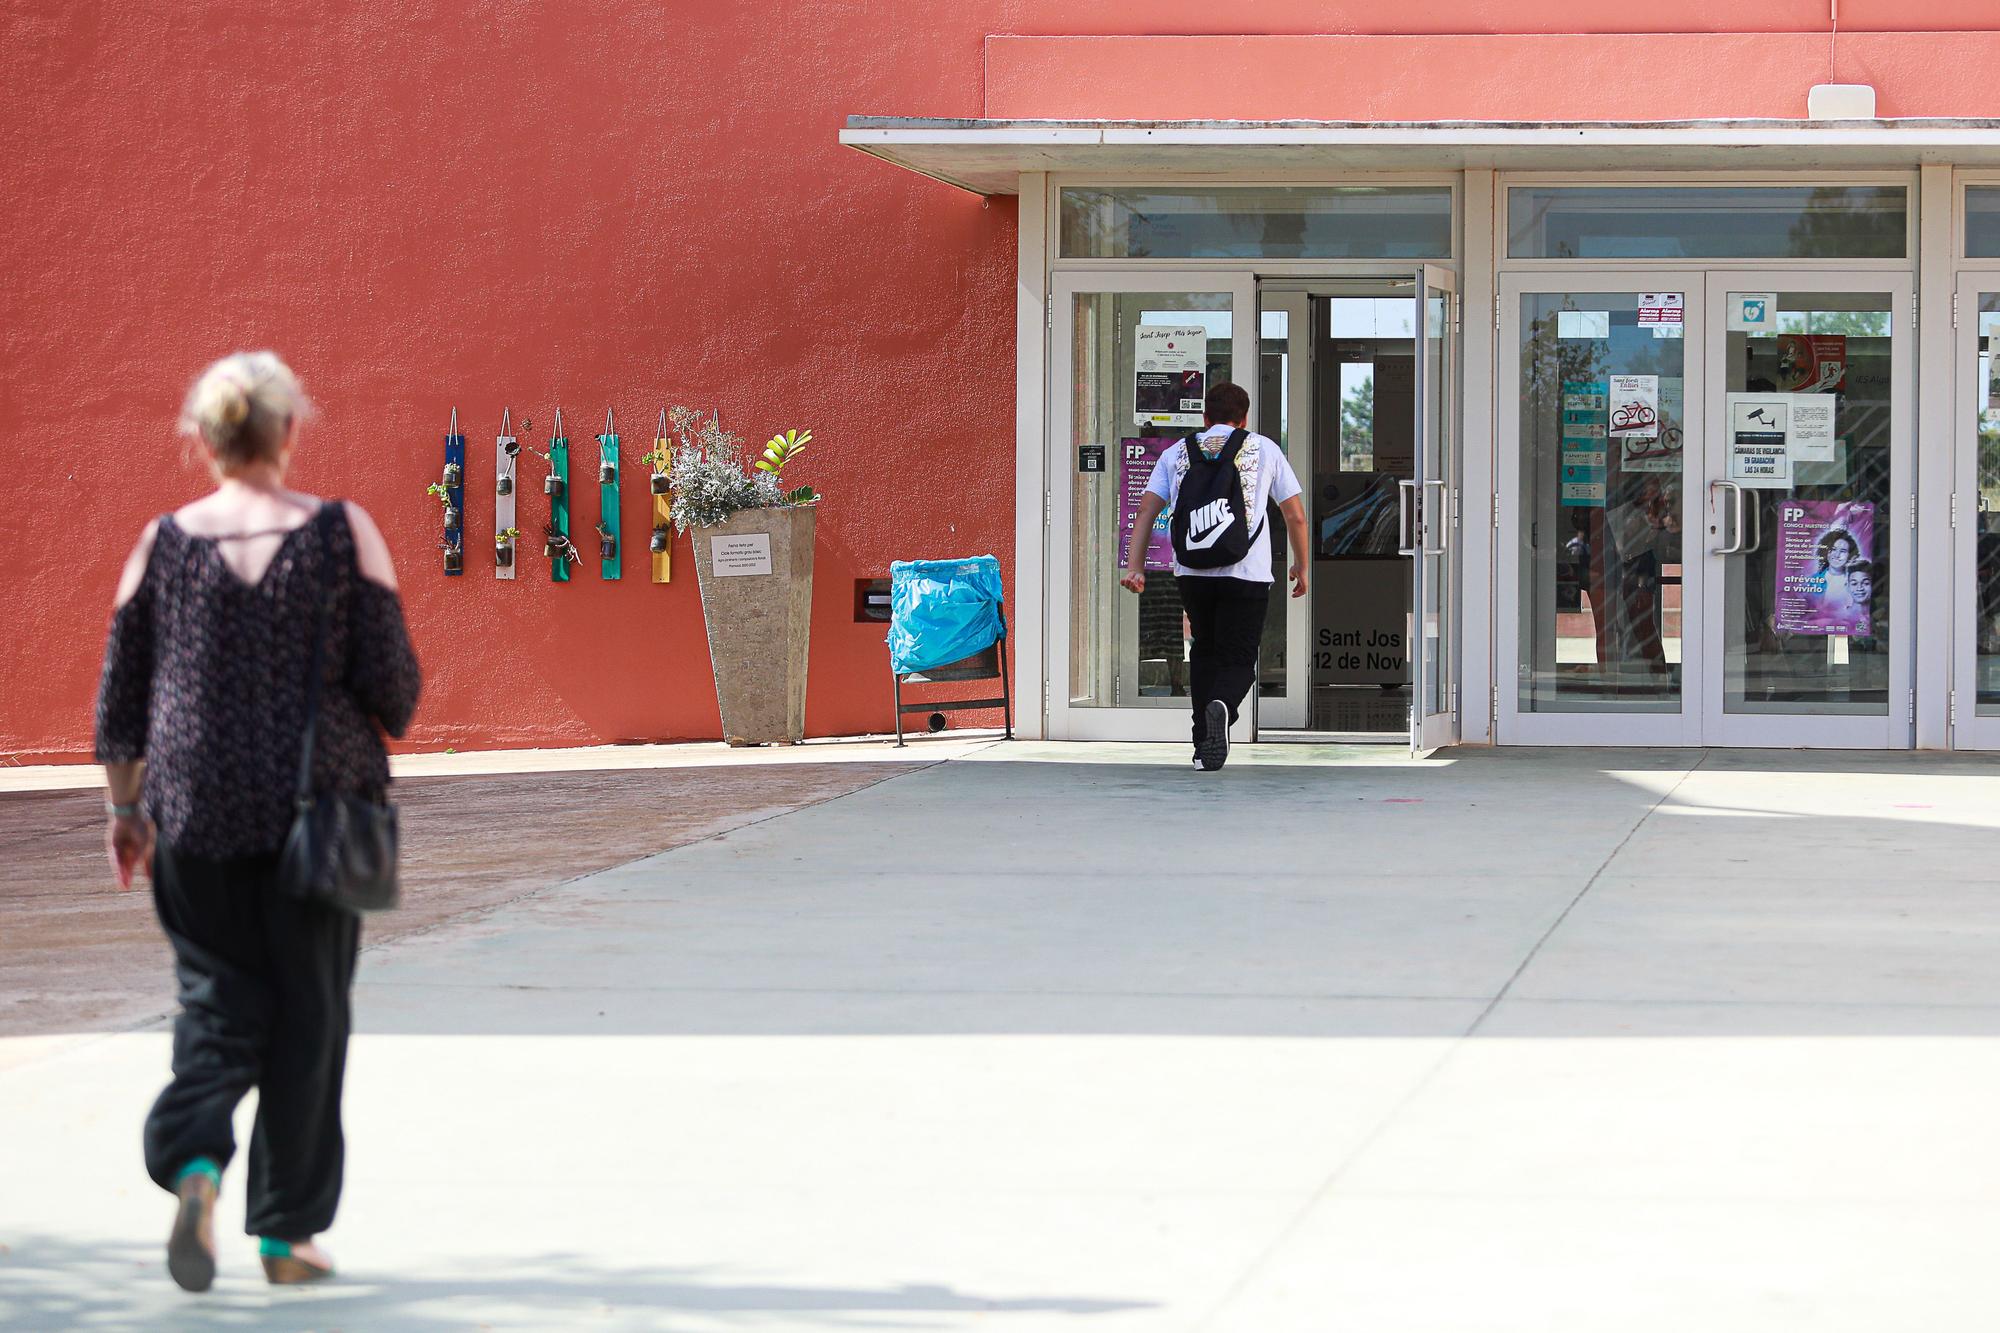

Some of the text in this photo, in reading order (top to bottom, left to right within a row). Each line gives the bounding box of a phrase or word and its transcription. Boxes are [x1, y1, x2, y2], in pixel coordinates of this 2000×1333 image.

[1140, 331, 1154, 339] Sant
[1125, 446, 1146, 459] FP
[1735, 446, 1755, 454] CÁMARAS
[1751, 456, 1776, 464] GRABACIÓN
[1190, 498, 1234, 538] NIKE
[1783, 508, 1804, 521] FP
[1784, 575, 1825, 584] atrévete
[1793, 584, 1823, 593] vivirlo
[1319, 628, 1400, 647] Sant Jos
[1338, 652, 1360, 670] de
[1366, 652, 1403, 670] Nov
